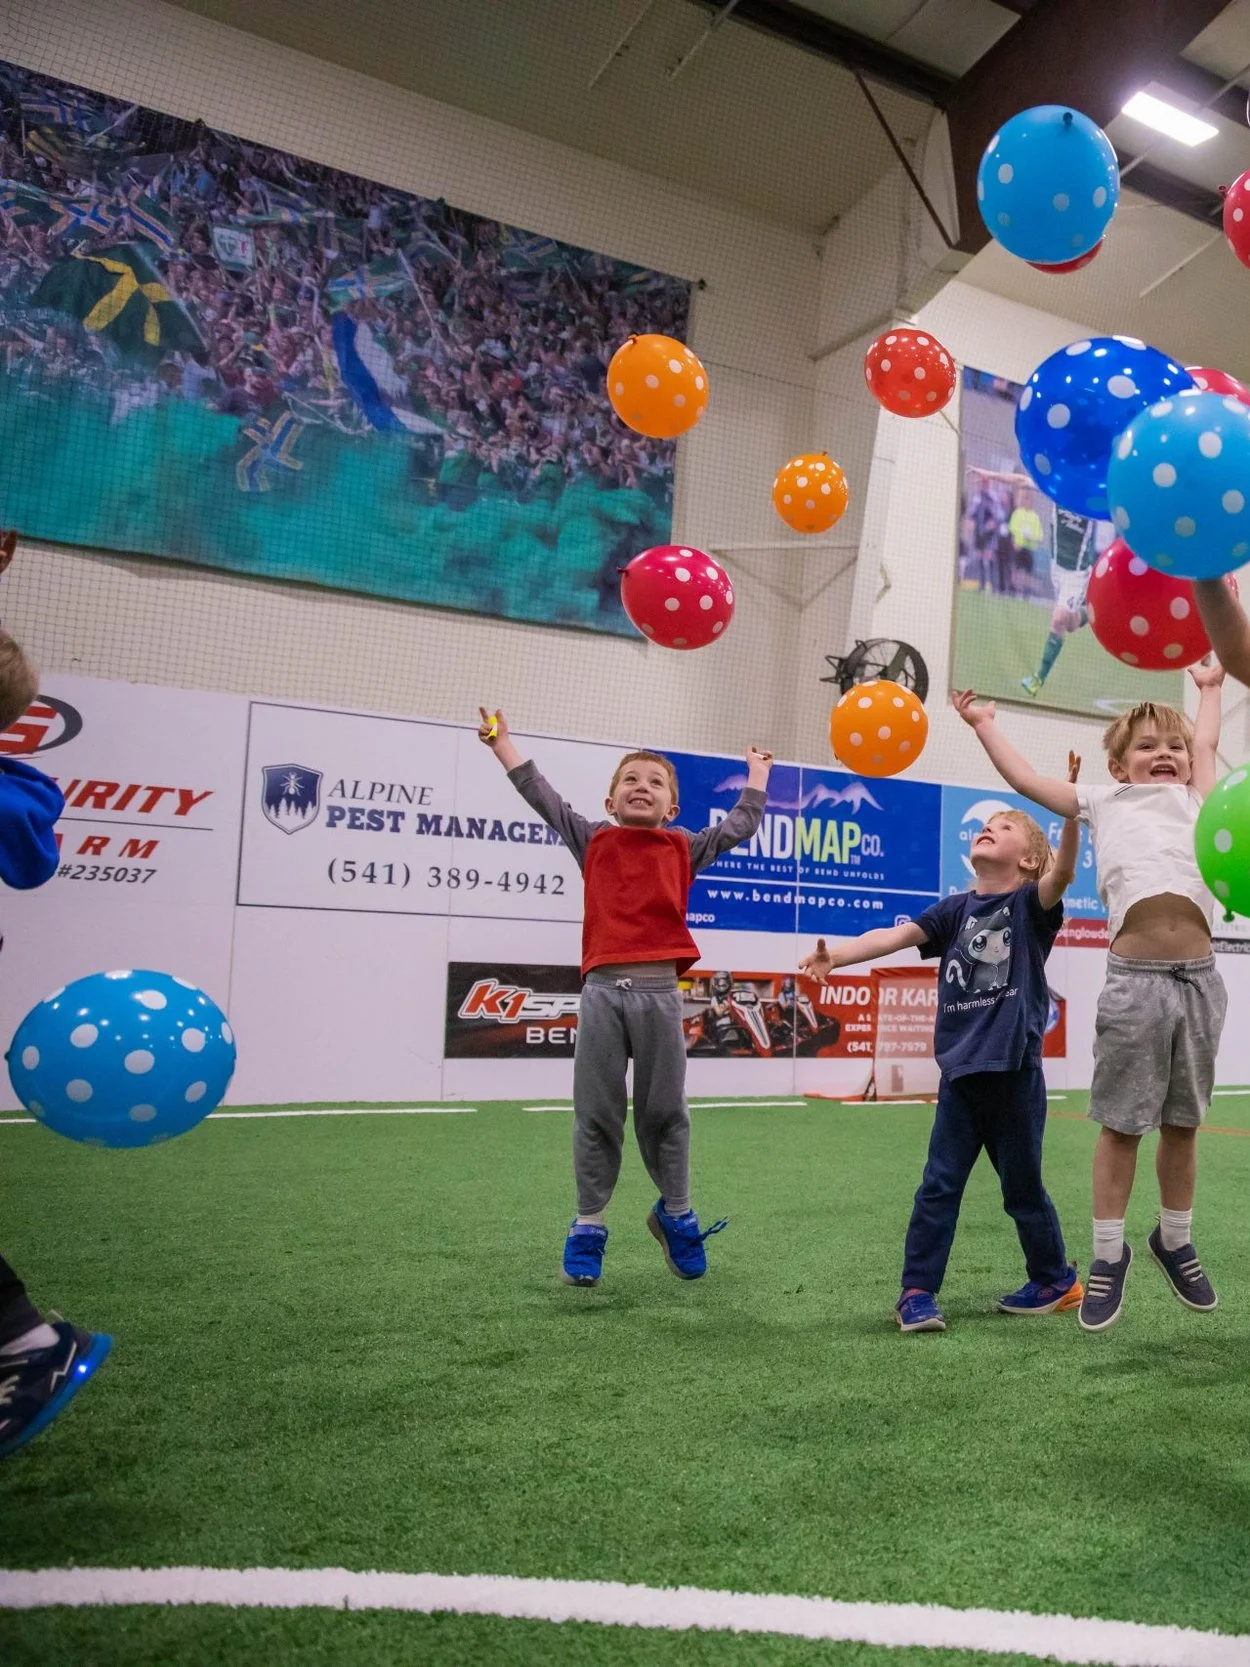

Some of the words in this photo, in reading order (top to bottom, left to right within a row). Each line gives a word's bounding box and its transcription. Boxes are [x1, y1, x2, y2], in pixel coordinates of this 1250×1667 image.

[328, 778, 434, 806] ALPINE
[326, 805, 405, 833] PEST
[53, 832, 160, 859] RM
[709, 808, 861, 865] NDMAP
[57, 864, 156, 883] #235037
[327, 858, 411, 888] (541)
[427, 866, 565, 895] 389-4942
[748, 863, 765, 871] THE
[770, 864, 793, 873] BEST
[815, 868, 838, 877] BEND
[844, 870, 884, 881] UNFOLDS
[707, 889, 884, 910] www.bendmapco.com
[957, 996, 995, 1011] harmless
